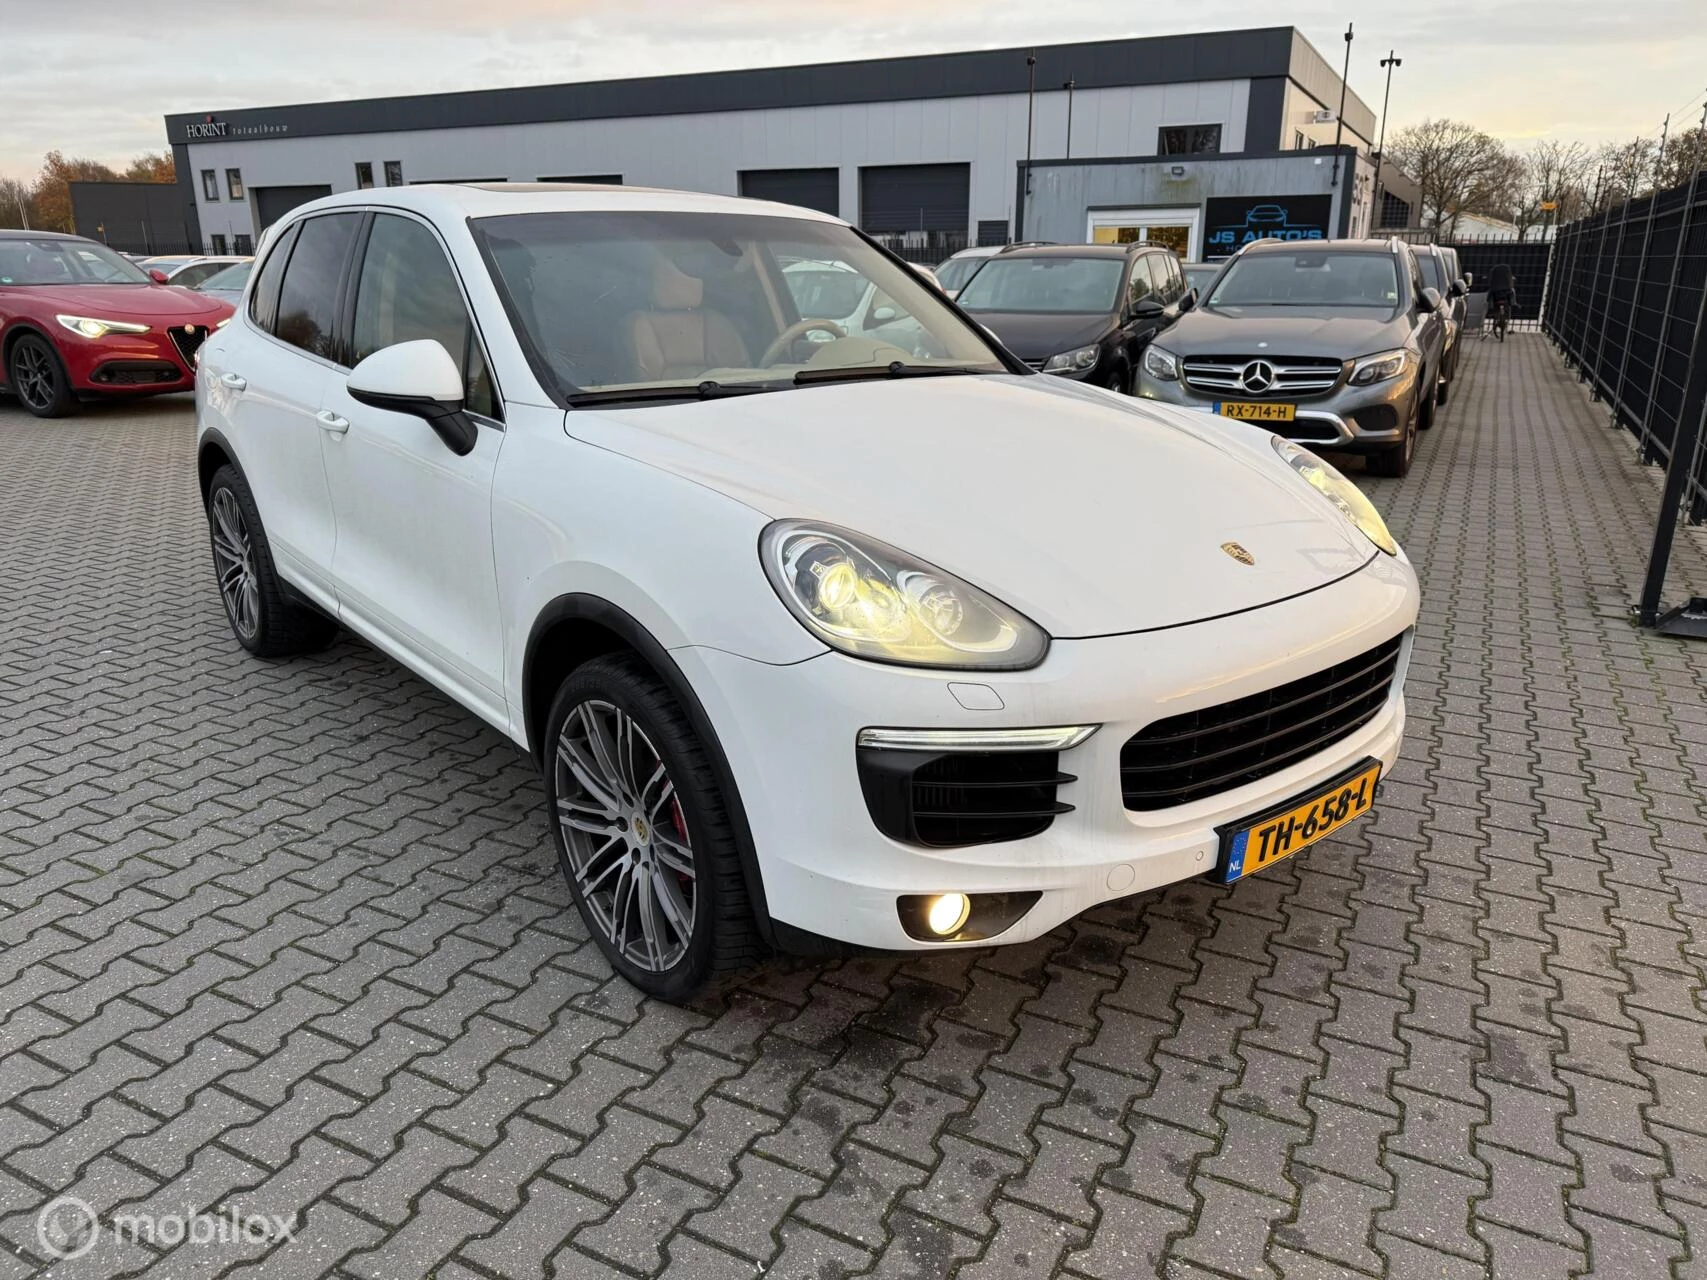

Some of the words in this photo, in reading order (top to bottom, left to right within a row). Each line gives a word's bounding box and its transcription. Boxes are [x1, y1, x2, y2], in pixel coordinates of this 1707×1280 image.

[1209, 231, 1236, 244] JS
[1226, 404, 1287, 419] RX-714-H
[1258, 777, 1368, 862] TH-658-L
[1229, 859, 1241, 873] NL
